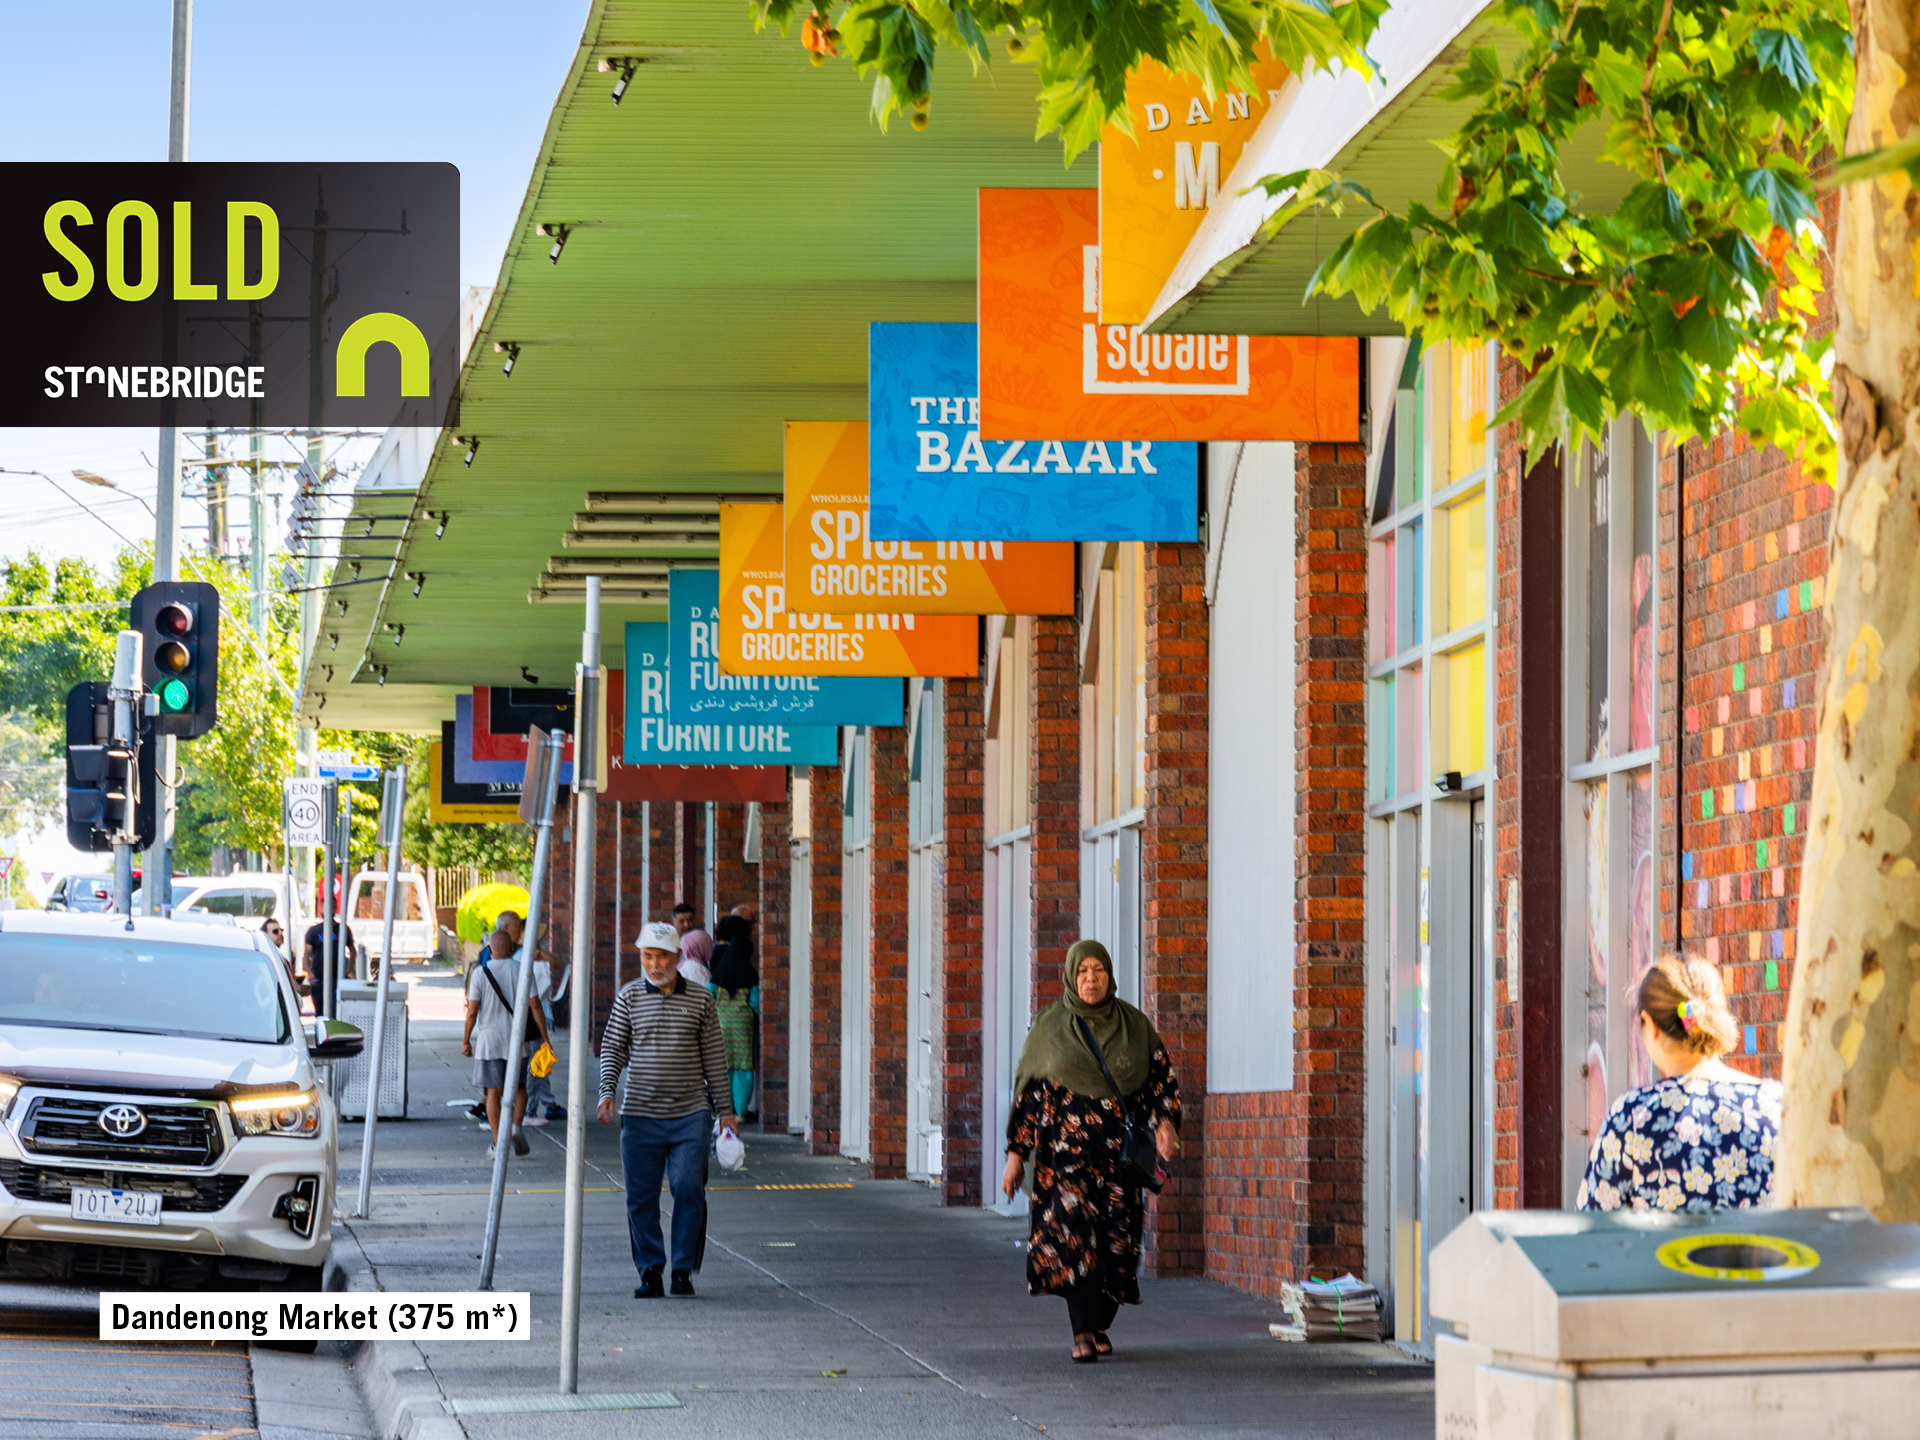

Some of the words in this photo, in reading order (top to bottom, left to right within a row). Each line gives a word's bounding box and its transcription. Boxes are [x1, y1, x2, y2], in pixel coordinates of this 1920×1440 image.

[1174, 140, 1250, 210] M
[916, 430, 1158, 474] BAZAAR
[810, 564, 948, 597] GROCERIES
[741, 632, 865, 662] GROCERIES
[641, 670, 670, 714] R
[292, 783, 319, 796] END
[295, 806, 316, 821] 40
[290, 832, 320, 843] AREA
